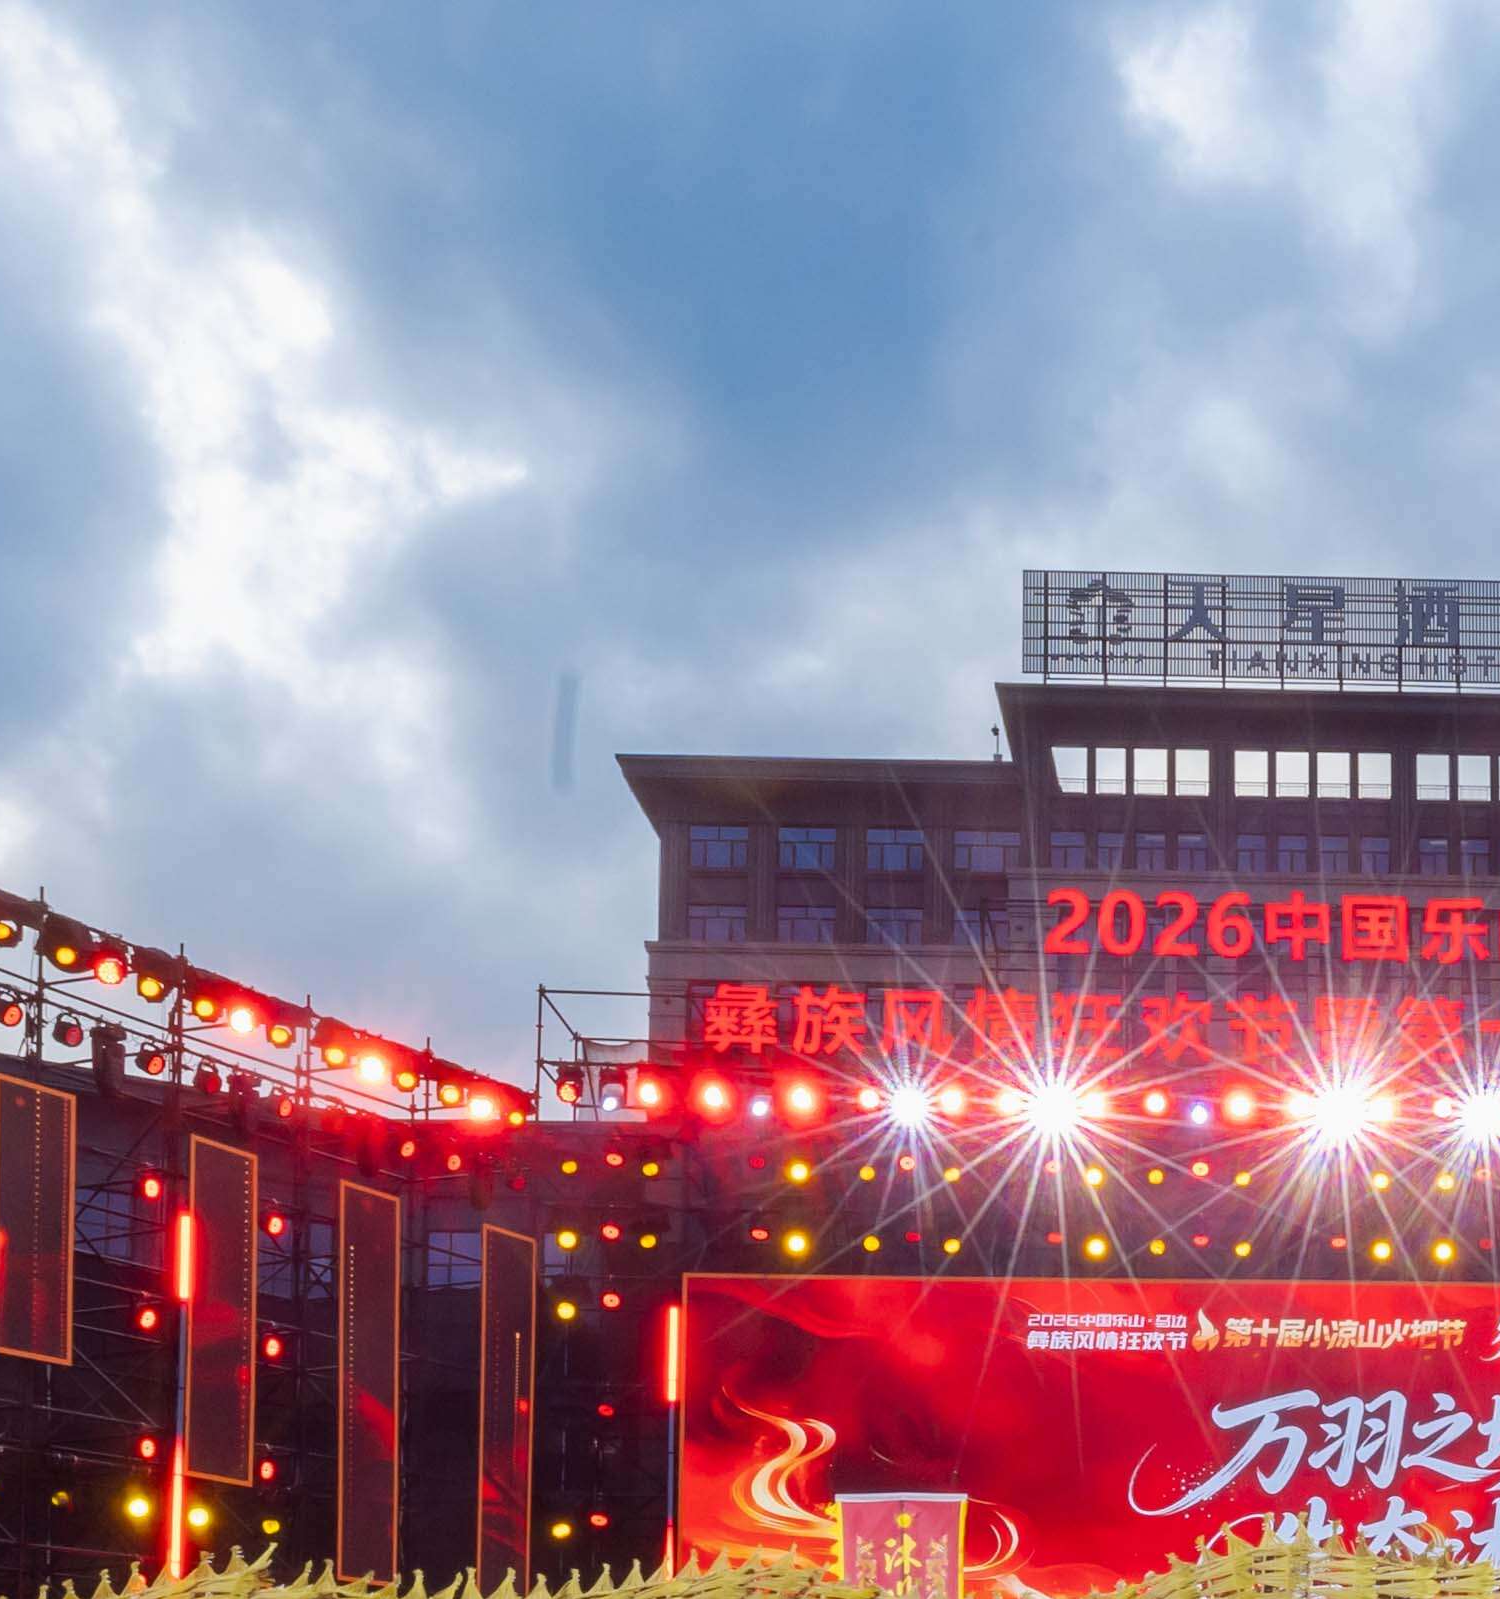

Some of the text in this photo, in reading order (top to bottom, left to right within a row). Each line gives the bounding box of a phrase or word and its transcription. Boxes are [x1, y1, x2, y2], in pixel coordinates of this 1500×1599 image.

[1207, 649, 1401, 674] TIANXING
[1026, 1330, 1189, 1351] 彝族风情狂欢节
[1223, 1317, 1467, 1351] 第十届小凉山火把节
